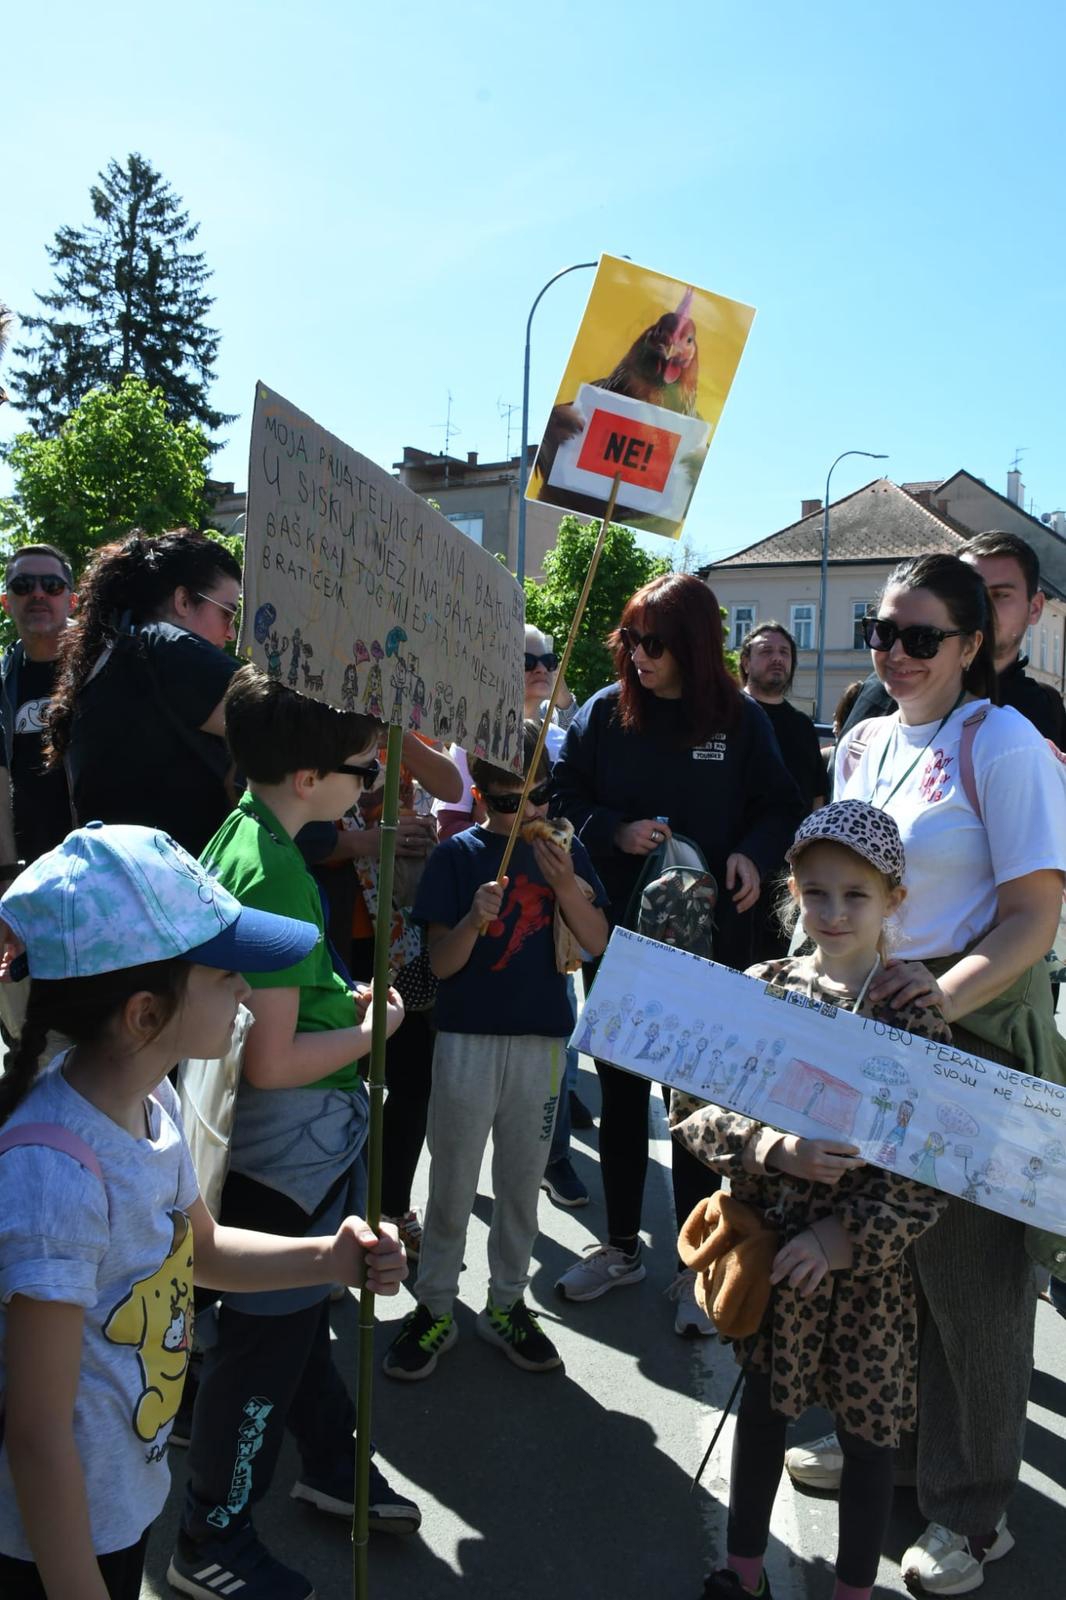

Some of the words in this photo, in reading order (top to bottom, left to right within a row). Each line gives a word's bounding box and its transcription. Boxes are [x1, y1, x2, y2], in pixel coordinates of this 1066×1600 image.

[603, 431, 655, 473] NE!
[265, 416, 308, 463] MOJA
[319, 446, 425, 560] PRIJATELJICA
[435, 533, 466, 595] IMA
[298, 470, 356, 546] SISKU
[266, 510, 300, 549] BAŠ
[925, 1040, 986, 1074] PERAD
[933, 1063, 977, 1089] SVOJU
[993, 1086, 1014, 1101] NE
